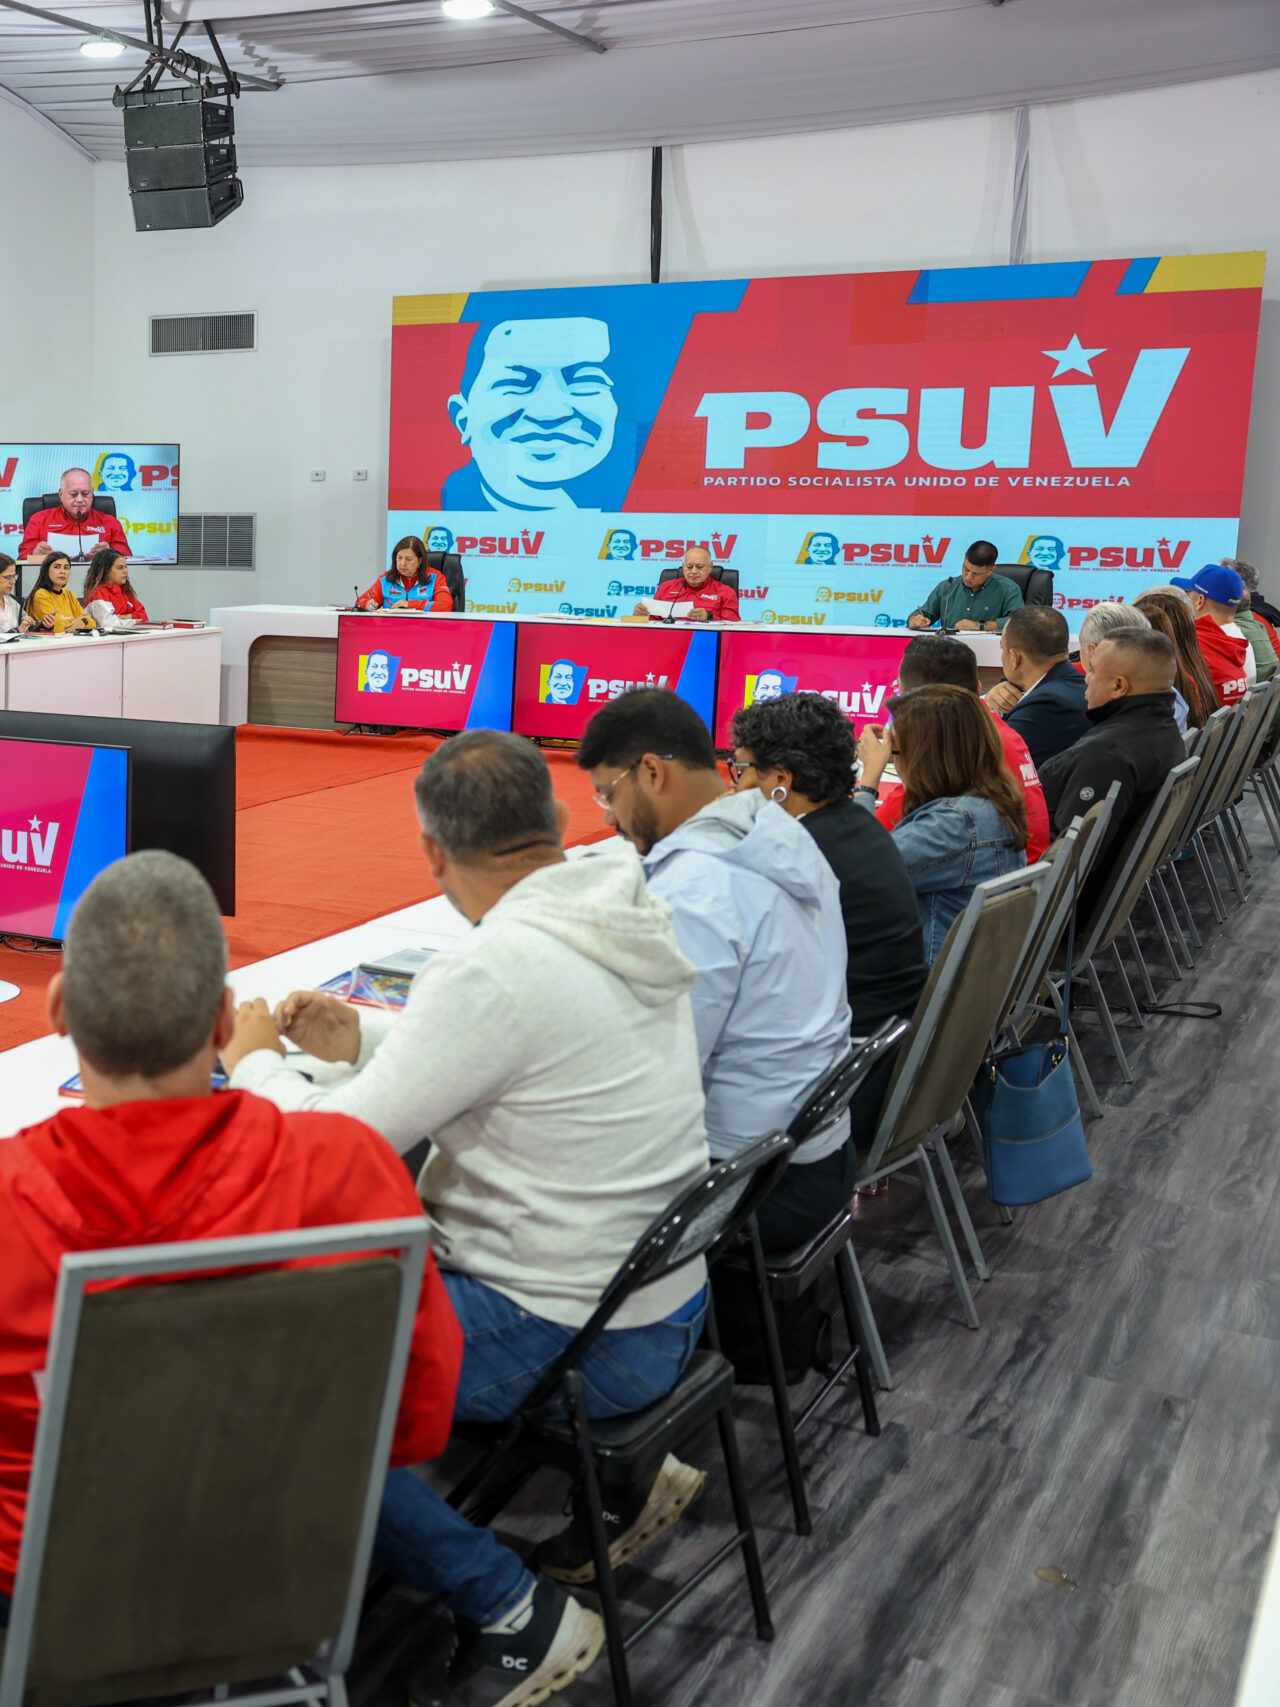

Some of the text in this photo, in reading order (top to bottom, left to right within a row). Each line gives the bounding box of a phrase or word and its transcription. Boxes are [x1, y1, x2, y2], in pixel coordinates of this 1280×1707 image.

[694, 346, 1191, 471] PSUV
[703, 476, 1131, 487] PARTIDO SOCIALISTA UNIDO DE VENEZUELA
[455, 531, 545, 555] PSUV
[842, 537, 952, 564] PSUV
[1067, 540, 1192, 568] PSUV
[400, 664, 472, 690] PSUV
